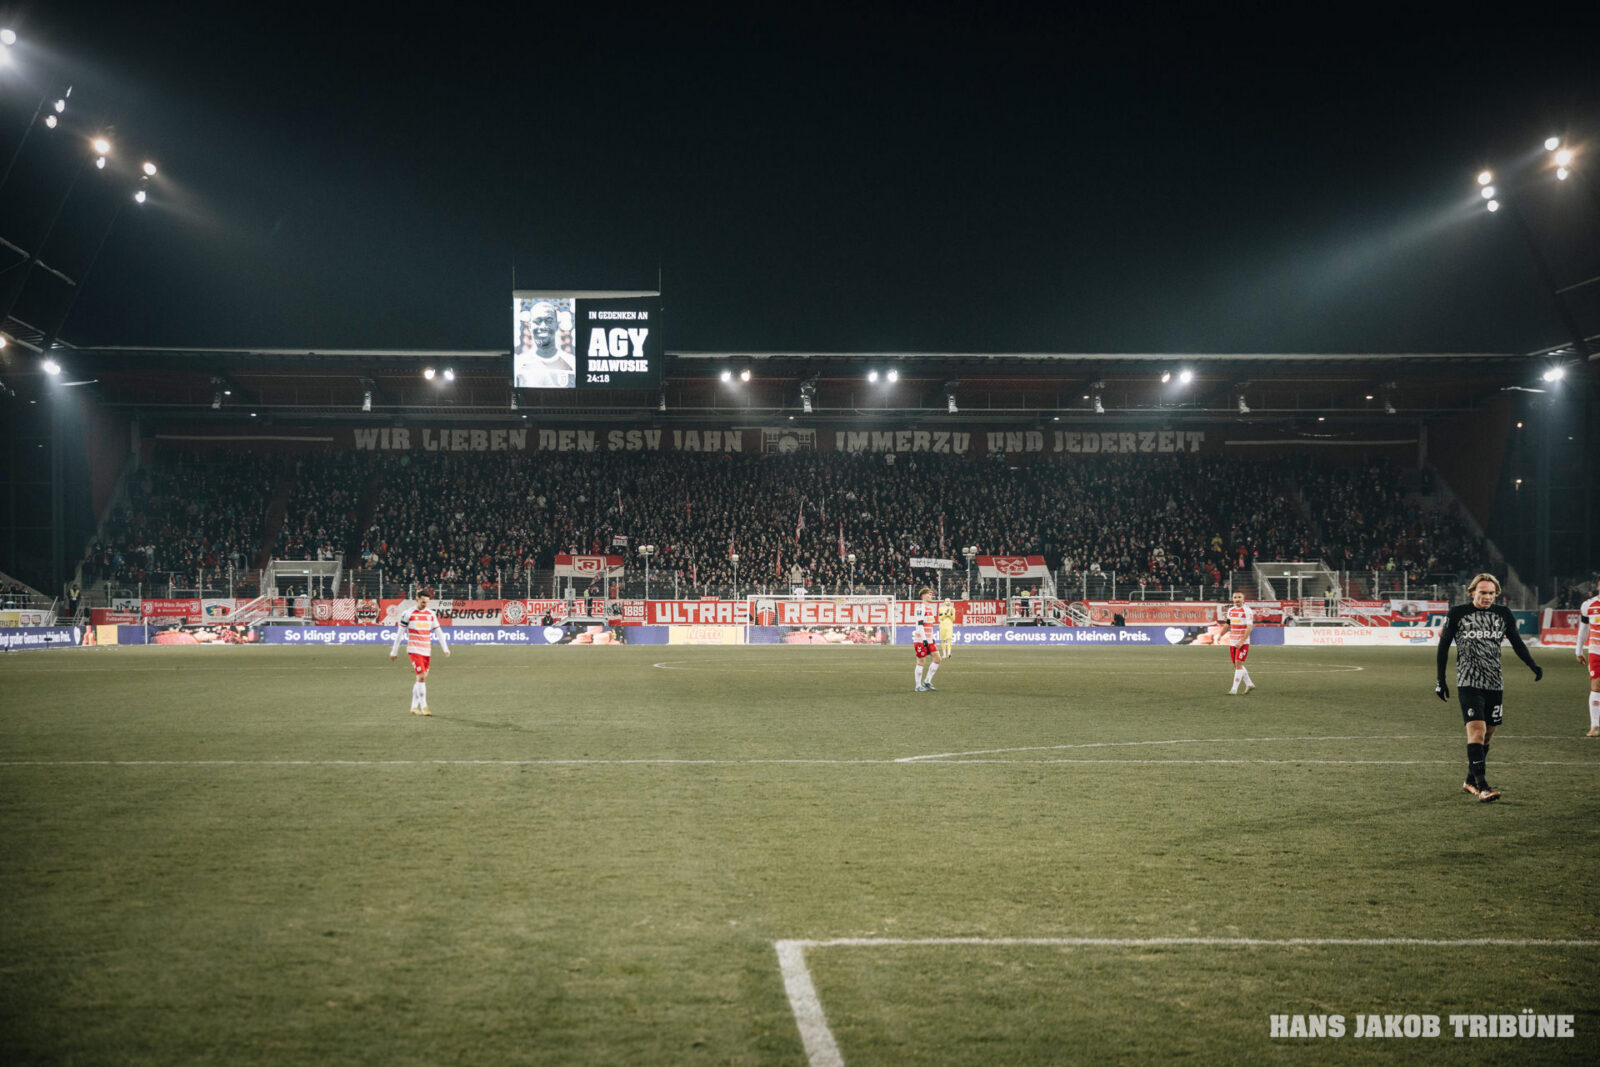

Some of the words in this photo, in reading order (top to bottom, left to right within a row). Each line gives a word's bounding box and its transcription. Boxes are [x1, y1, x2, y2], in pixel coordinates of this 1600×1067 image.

[589, 312, 597, 320] IN
[598, 312, 636, 320] GEDENKEN
[638, 312, 649, 320] AN
[588, 328, 649, 357] AGY
[588, 360, 649, 372] DIAWUSIE
[587, 375, 610, 383] 24:18
[353, 428, 411, 450] WIR
[422, 429, 528, 451] LIEBEN
[539, 430, 595, 452] DEN
[607, 430, 662, 451] SSV
[836, 430, 971, 454] IMMERZU
[987, 432, 1042, 453] UND
[1053, 431, 1205, 453] JEDERZEIT
[624, 606, 644, 616] 1889
[656, 603, 750, 623] ULTRAS
[967, 602, 997, 614] JAHN
[967, 616, 997, 624] STADION
[285, 630, 301, 641] So
[304, 630, 336, 643] klingt
[338, 630, 378, 643] großer
[454, 630, 492, 641] kleinen
[497, 631, 530, 641] Preis.
[964, 631, 1003, 643] großer
[1005, 631, 1047, 641] Genuss
[1077, 630, 1116, 641] kleinen
[1119, 631, 1151, 641] Preis.
[1462, 631, 1503, 640] JOBRAD
